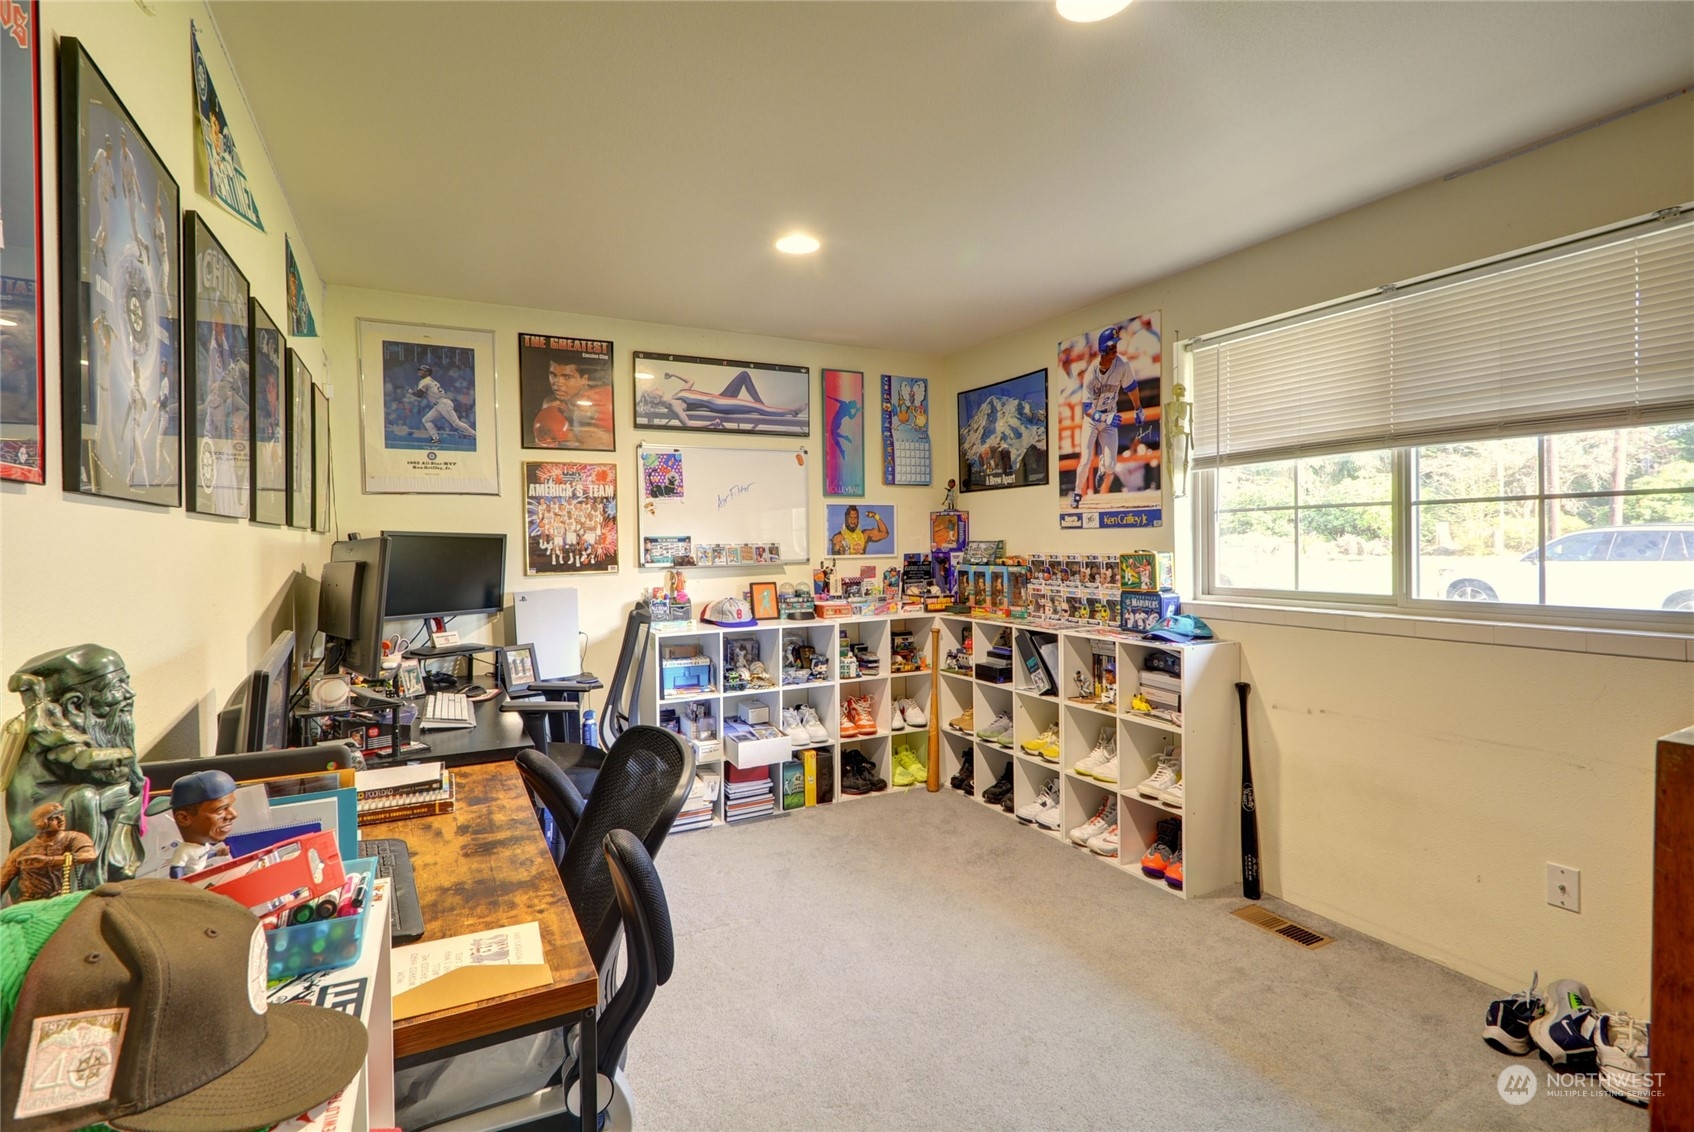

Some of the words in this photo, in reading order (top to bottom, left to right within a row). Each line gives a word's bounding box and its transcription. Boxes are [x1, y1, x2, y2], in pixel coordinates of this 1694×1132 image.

[523, 335, 546, 348] THE
[550, 337, 608, 354] GREATEST
[990, 475, 1002, 486] Brew
[528, 483, 583, 497] AMERICA'S
[588, 484, 614, 497] TEAM
[1103, 514, 1118, 525] Ken
[1118, 513, 1142, 526] Griffey
[42, 1019, 72, 1031] 1977
[96, 1014, 121, 1026] 2017
